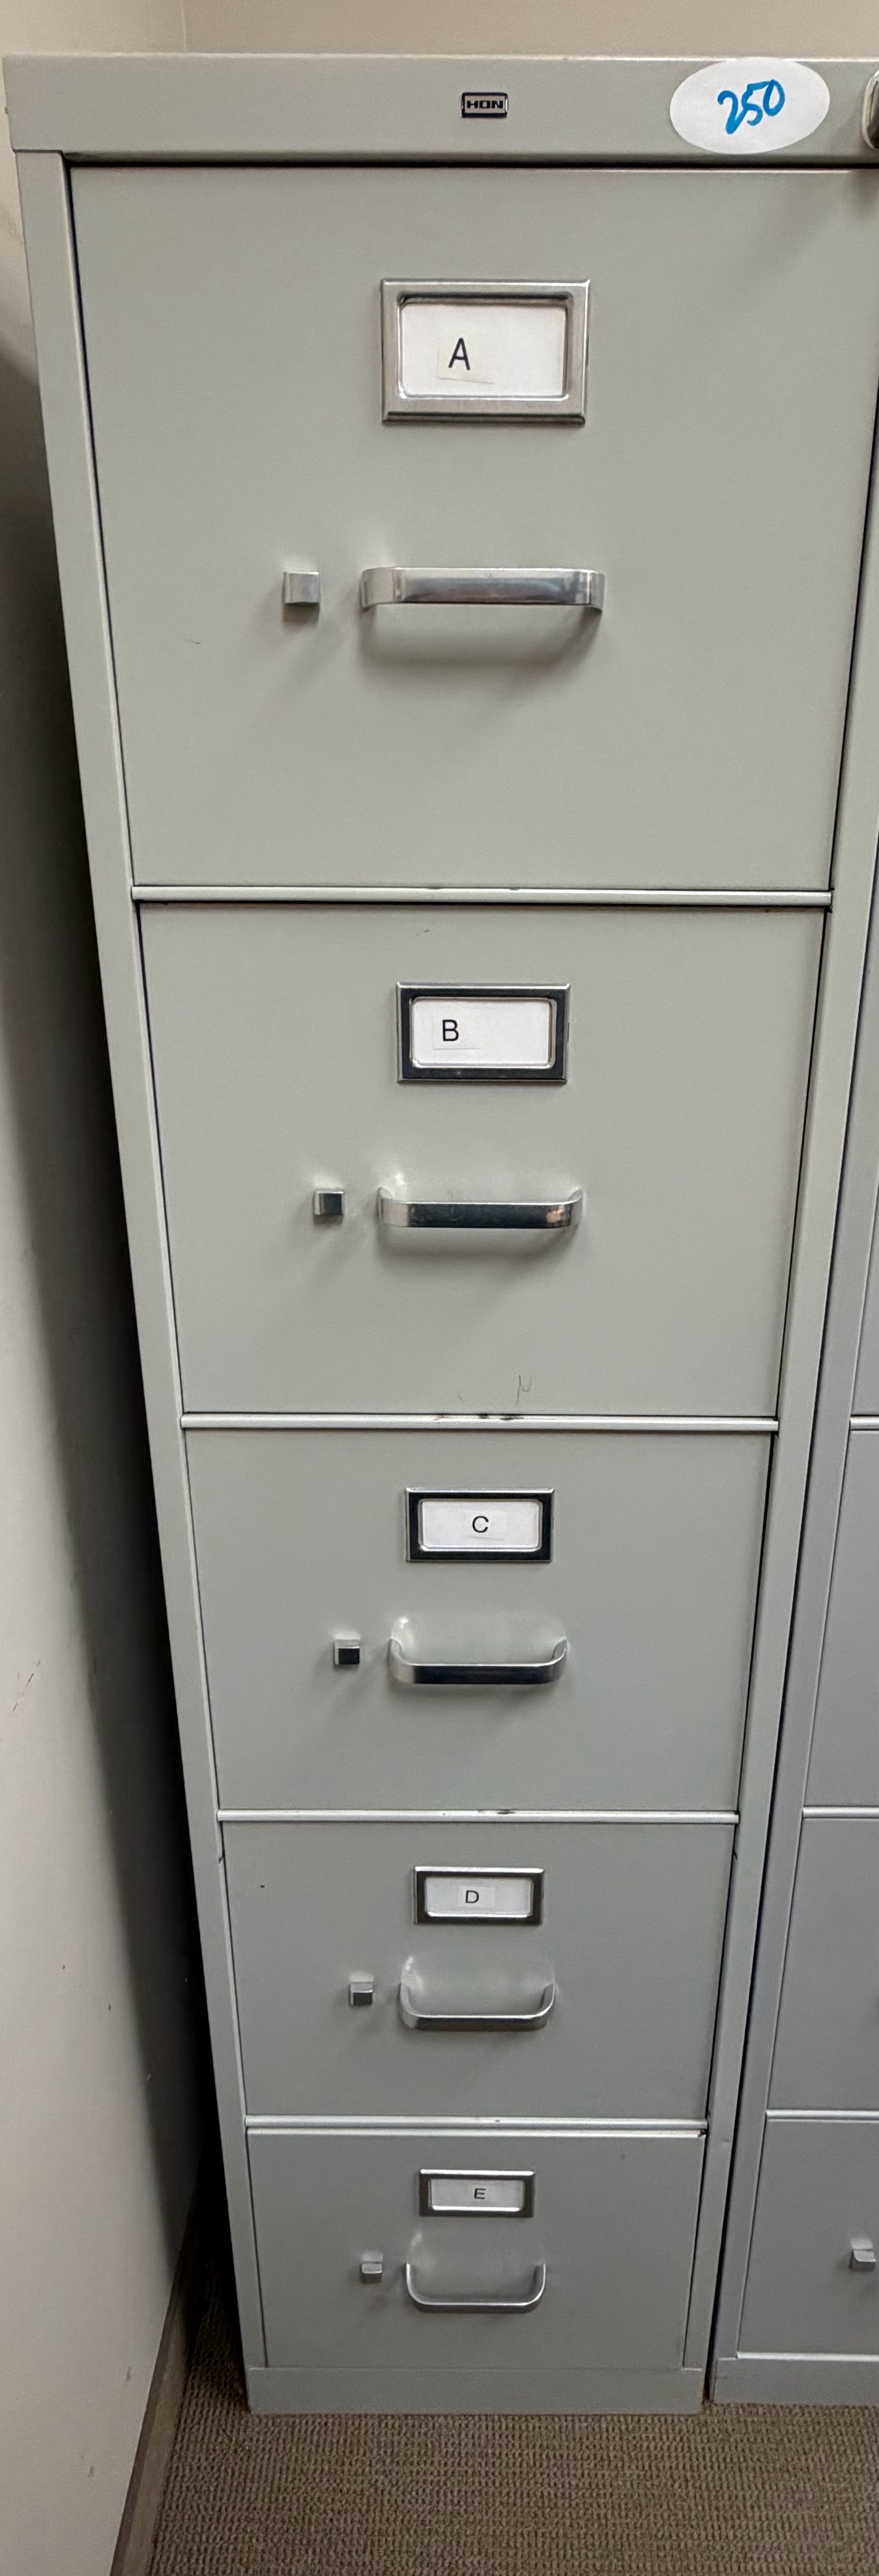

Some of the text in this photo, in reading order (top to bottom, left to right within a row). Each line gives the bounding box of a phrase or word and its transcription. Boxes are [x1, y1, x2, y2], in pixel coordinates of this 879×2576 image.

[467, 100, 503, 109] HON
[717, 79, 785, 134] 250
[448, 338, 470, 370] A
[442, 1019, 459, 1041] B
[472, 1516, 489, 1533] C
[465, 1890, 479, 1904] D
[474, 2188, 486, 2199] E
